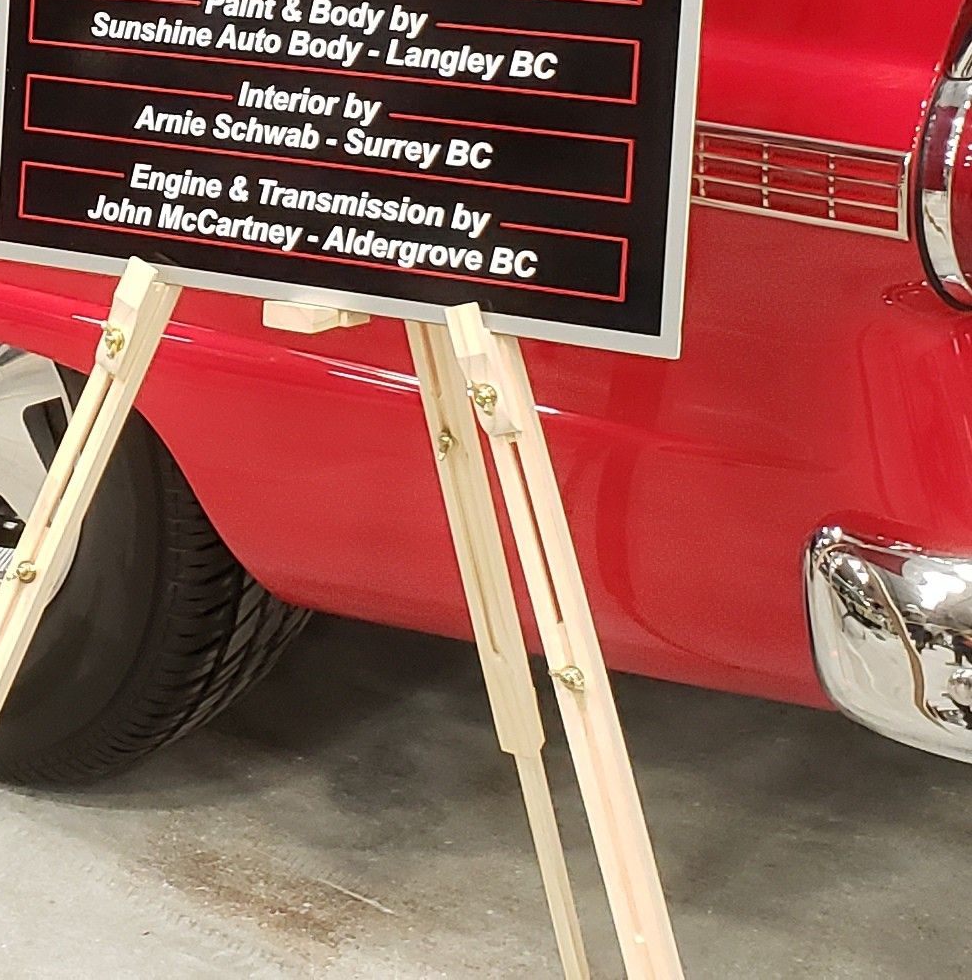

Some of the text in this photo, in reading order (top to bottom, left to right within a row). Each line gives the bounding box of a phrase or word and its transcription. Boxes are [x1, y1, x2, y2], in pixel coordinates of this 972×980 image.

[90, 11, 560, 81] Sunshine Auto Body - Langley BC
[388, 4, 429, 40] by
[133, 104, 495, 171] Arnie Schwab - Surrey BC
[237, 80, 383, 127] Interior by
[129, 162, 492, 239] Engine & Transmission by
[87, 194, 539, 278] John McCartney - Aldergrove BC
